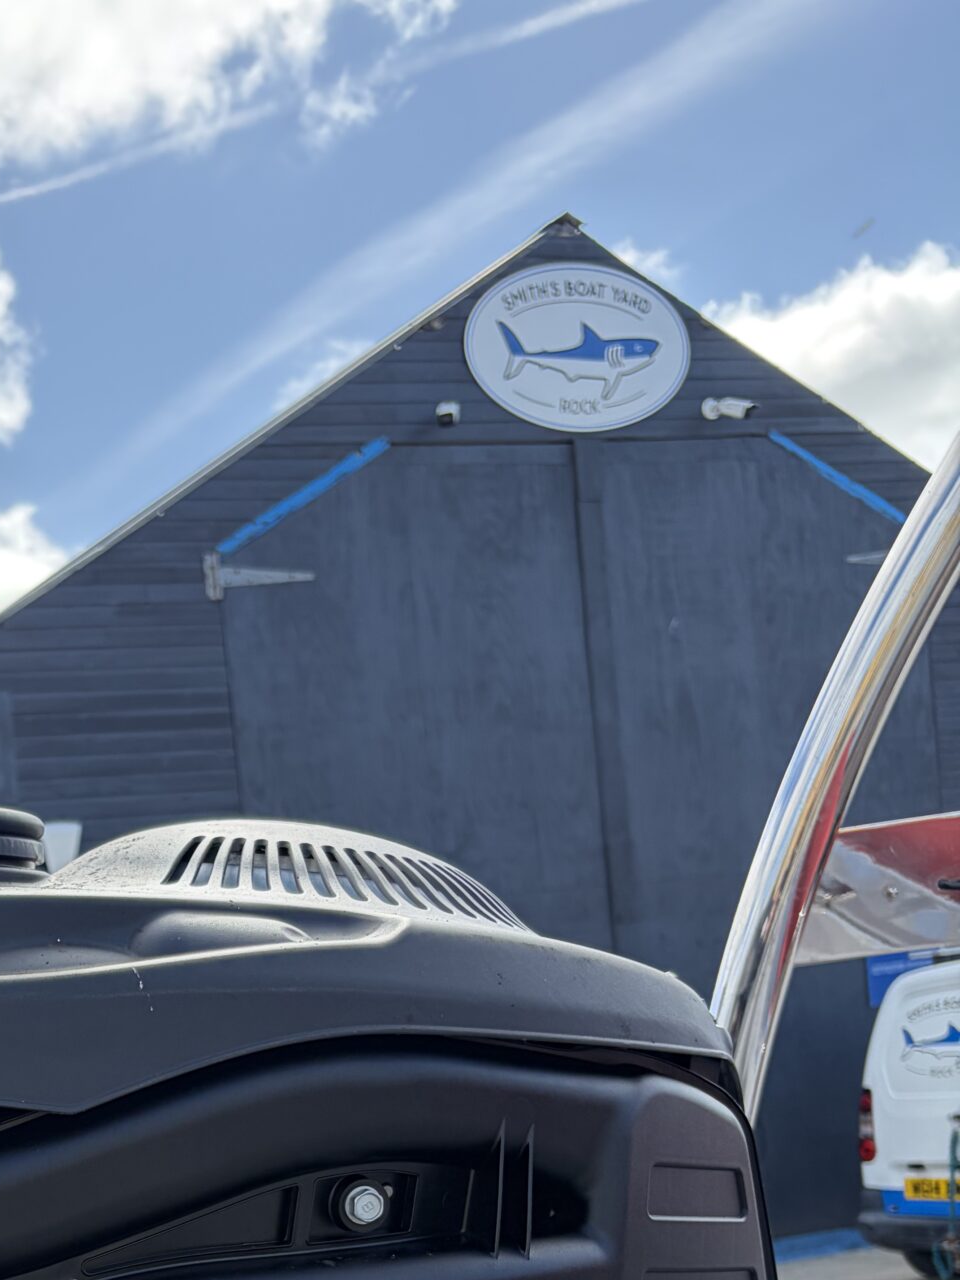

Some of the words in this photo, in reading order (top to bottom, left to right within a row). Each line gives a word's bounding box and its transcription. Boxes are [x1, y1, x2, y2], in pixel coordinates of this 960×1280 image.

[501, 280, 561, 311] SMITH'S
[563, 280, 607, 297] BOAT
[610, 284, 653, 314] YARD
[558, 398, 602, 415] ROCK
